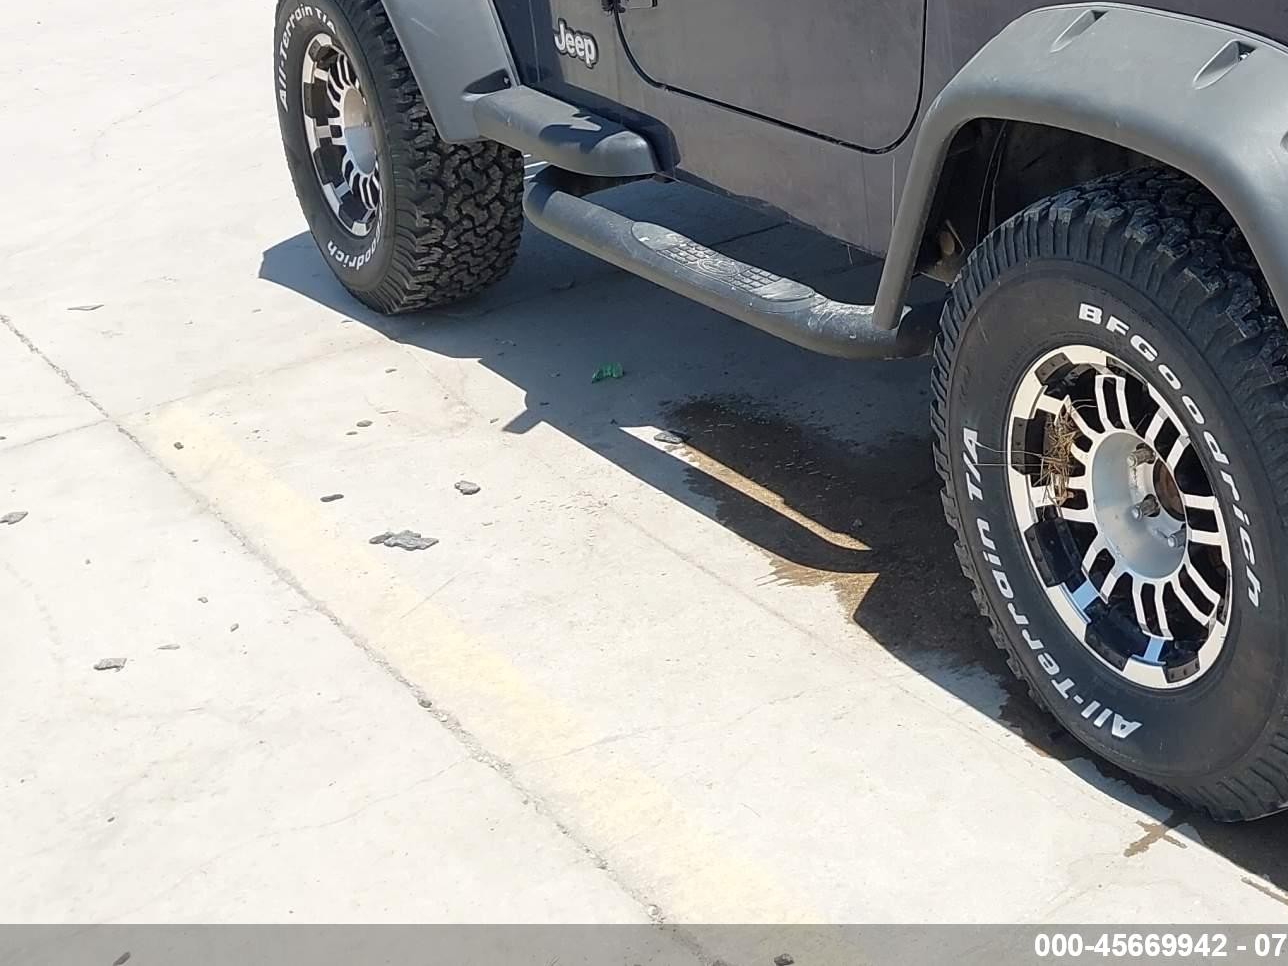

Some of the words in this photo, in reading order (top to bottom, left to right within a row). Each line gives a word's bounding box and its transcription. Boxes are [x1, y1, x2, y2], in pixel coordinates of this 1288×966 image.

[278, 4, 313, 112] All-Terrain
[315, 7, 336, 34] T/A
[554, 21, 597, 67] Jeep
[962, 427, 984, 502] T/A
[1078, 302, 1261, 608] BFGoodrich
[976, 518, 1143, 739] All-Terrain
